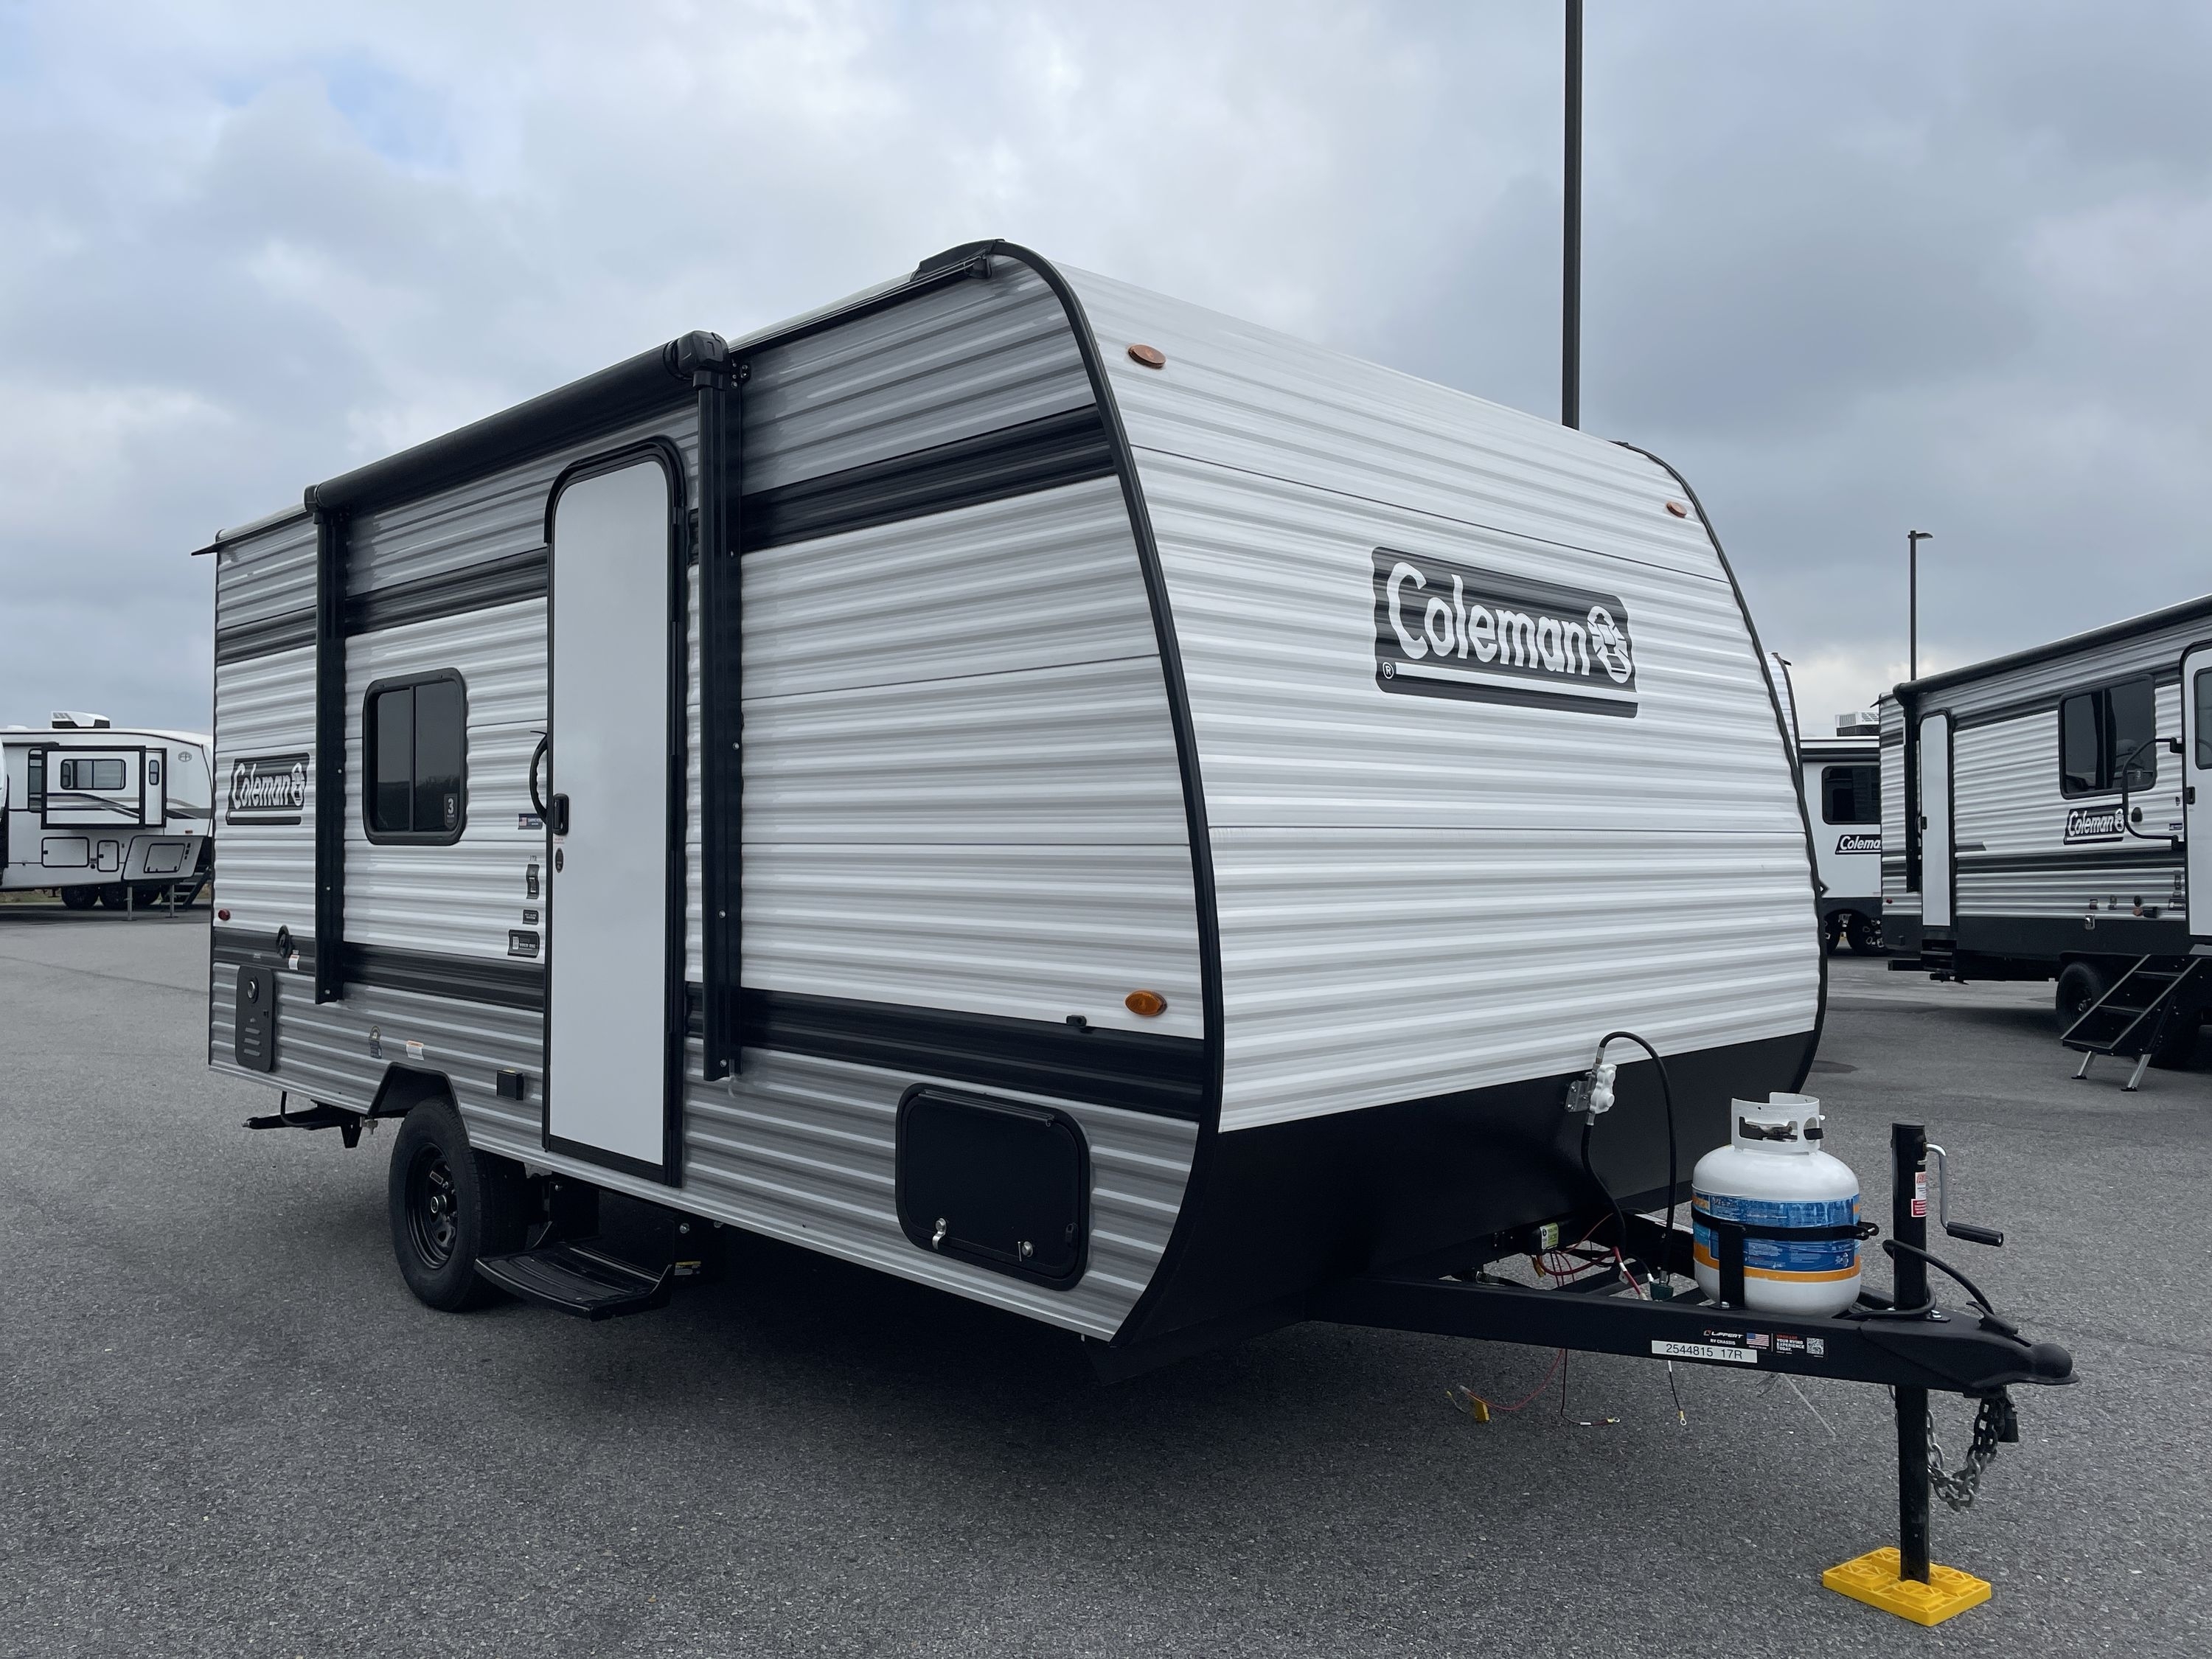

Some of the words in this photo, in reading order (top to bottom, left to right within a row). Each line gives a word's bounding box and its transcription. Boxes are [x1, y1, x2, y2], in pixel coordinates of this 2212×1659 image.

[1387, 562, 1590, 676] Coleman
[232, 762, 291, 810] Coleman
[448, 798, 454, 814] 3
[2068, 811, 2114, 837] Coleman
[1840, 835, 1881, 850] Colema
[1666, 1343, 1714, 1357] 2544815
[1720, 1349, 1743, 1360] 17R
